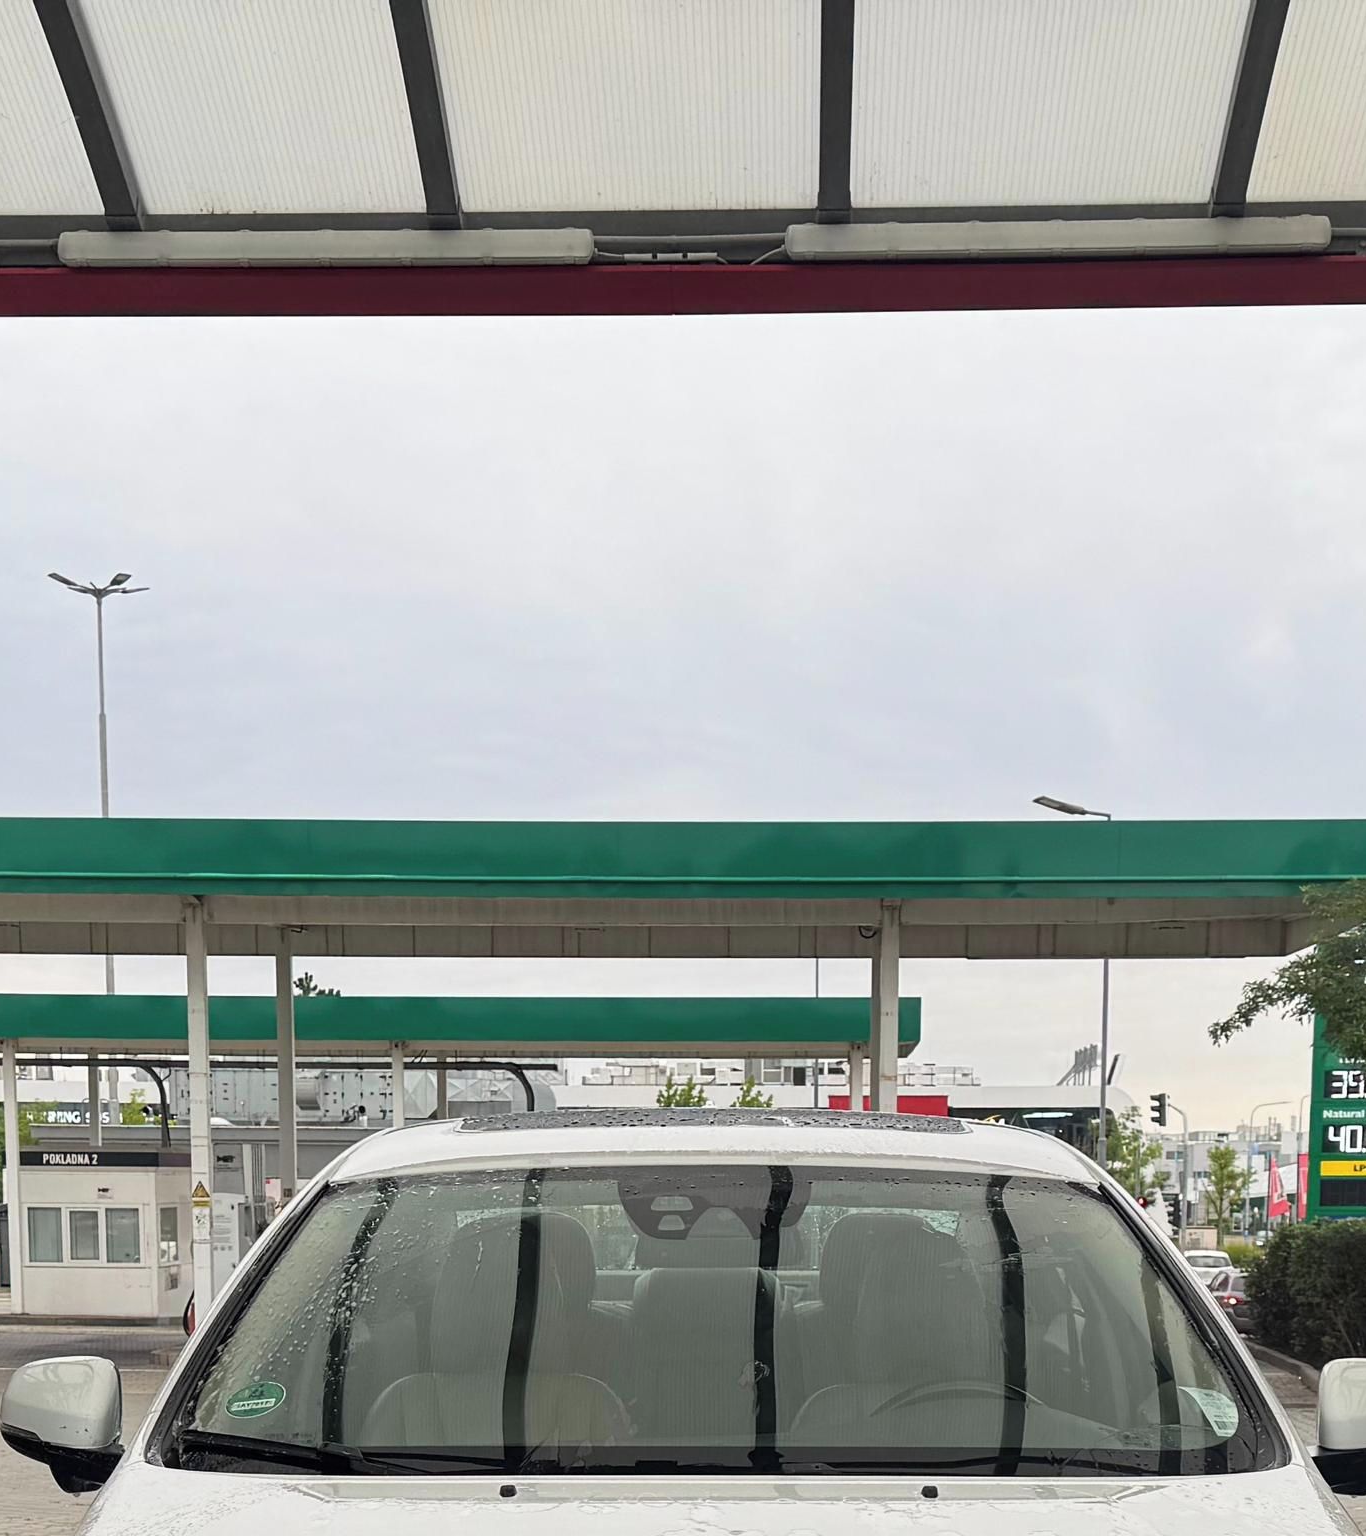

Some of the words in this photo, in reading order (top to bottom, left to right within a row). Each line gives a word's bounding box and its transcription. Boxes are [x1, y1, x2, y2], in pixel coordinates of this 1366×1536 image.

[1322, 1109, 1365, 1119] Natural
[42, 1153, 90, 1165] POKLADNA
[91, 1153, 98, 1165] 2
